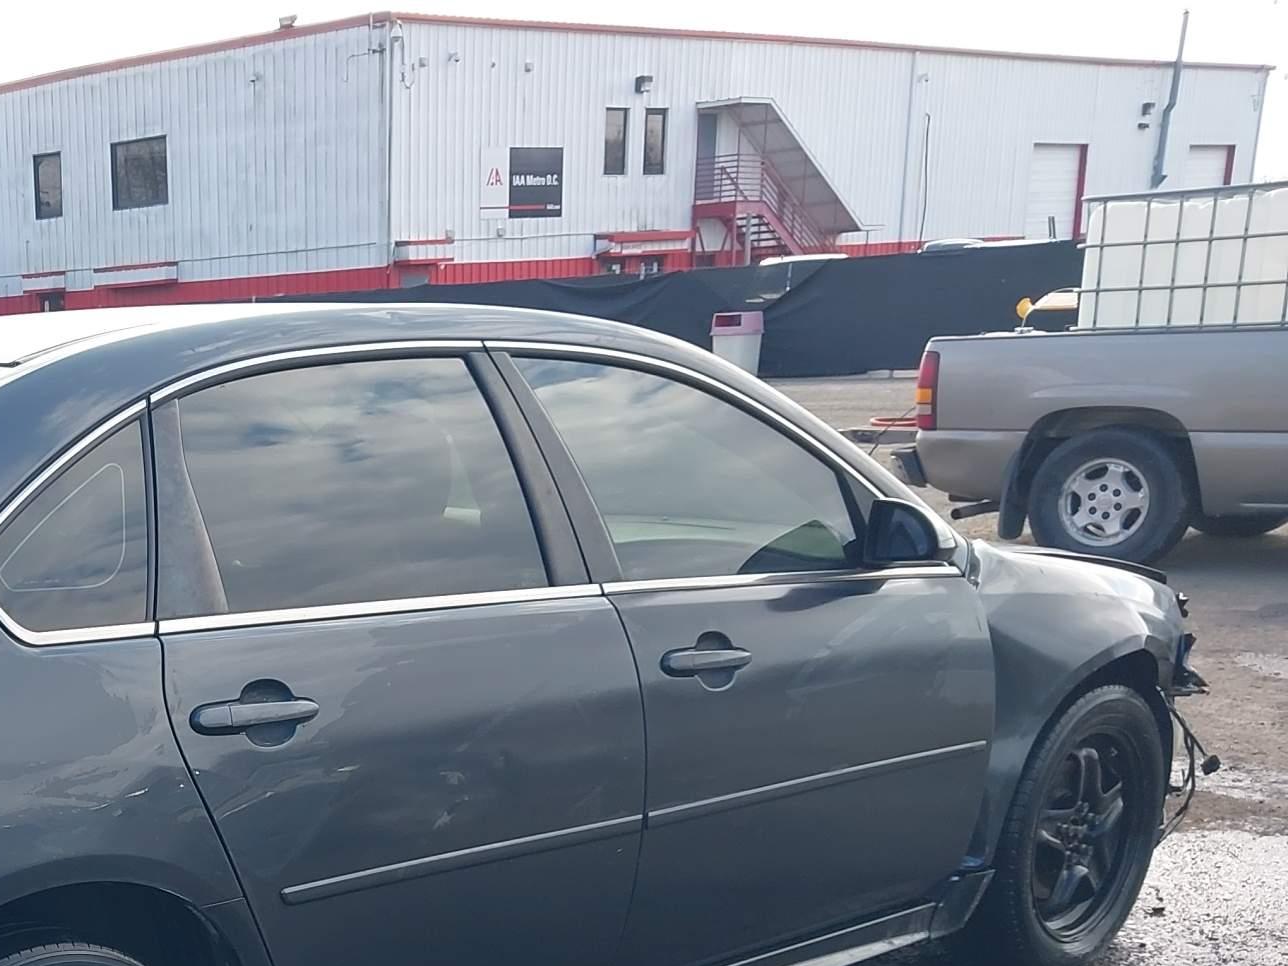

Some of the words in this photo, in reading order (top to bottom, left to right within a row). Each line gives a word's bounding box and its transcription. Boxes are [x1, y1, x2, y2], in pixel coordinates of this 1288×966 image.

[512, 174, 525, 186] IAA
[526, 174, 546, 186] Metro
[546, 174, 560, 186] D.C.
